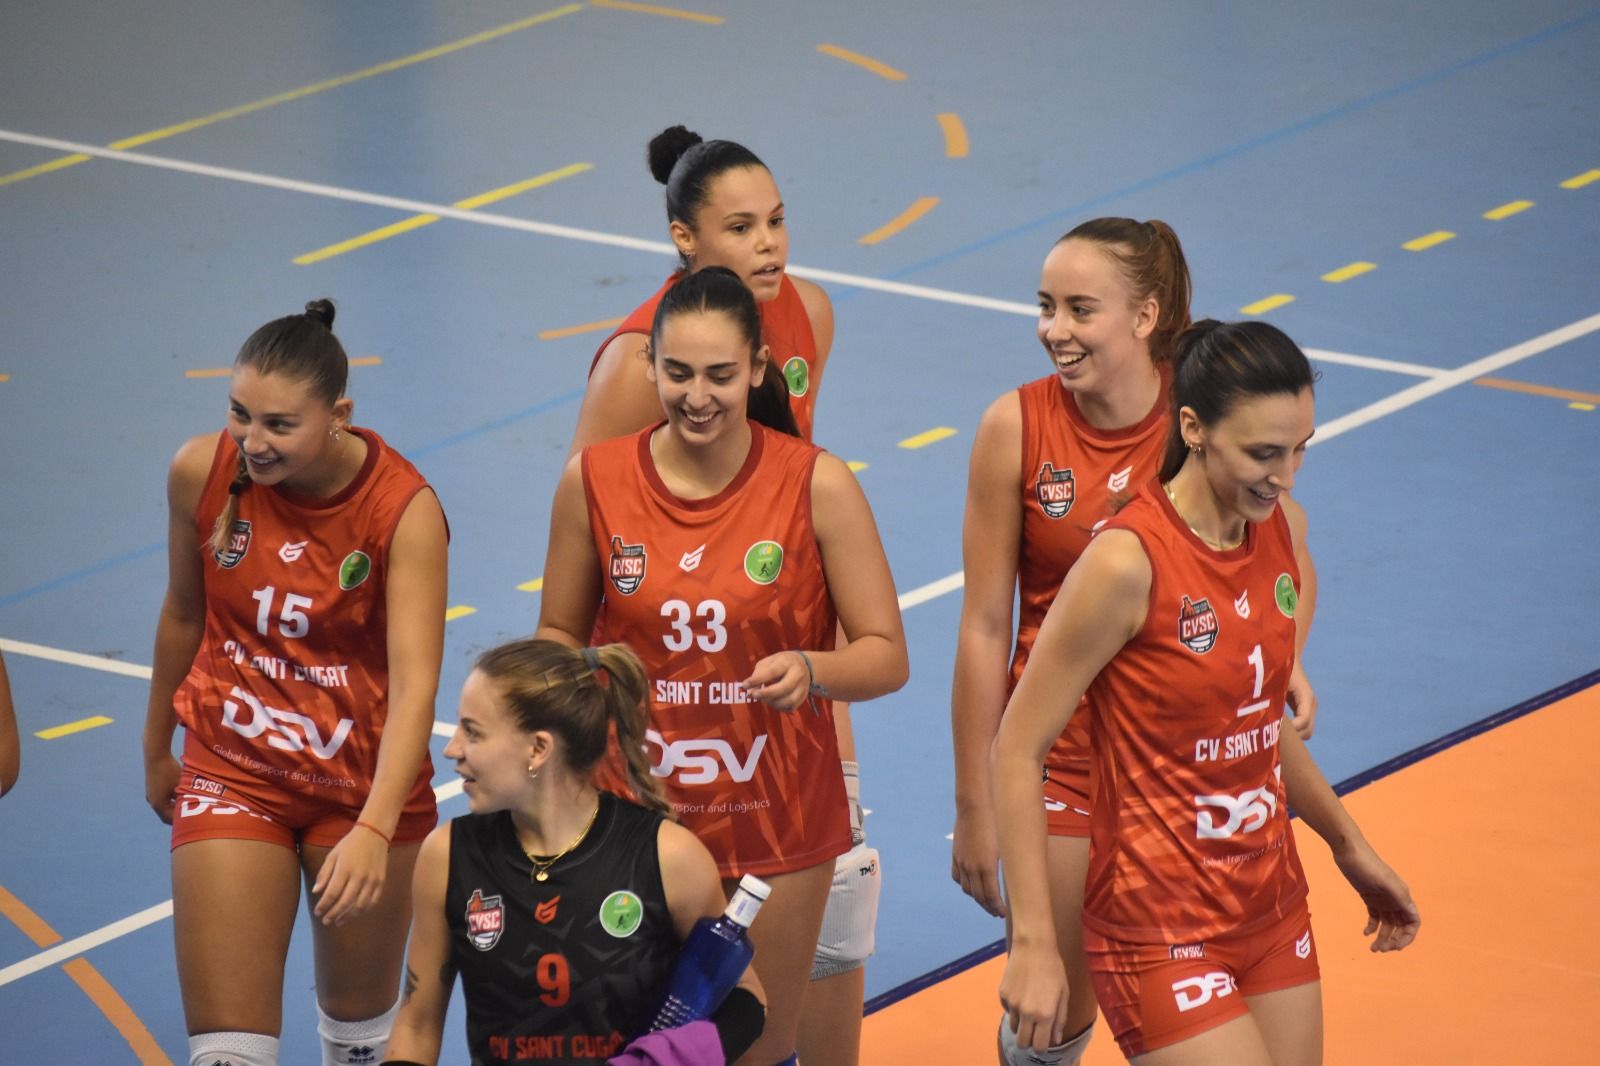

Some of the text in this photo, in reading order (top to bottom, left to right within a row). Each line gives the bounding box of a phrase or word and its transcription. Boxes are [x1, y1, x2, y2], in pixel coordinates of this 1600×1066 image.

[1040, 483, 1072, 501] CVSC
[612, 558, 643, 576] CVSC
[252, 585, 313, 639] 15
[1182, 611, 1216, 638] CVSC
[660, 599, 728, 652] 33
[250, 655, 288, 680] ANT
[1247, 644, 1266, 699] 1
[656, 679, 765, 705] SANT CUG
[221, 685, 355, 760] DSV
[1195, 738, 1221, 762] CV
[1224, 729, 1260, 760] SANT
[243, 755, 288, 778] Transport
[291, 770, 310, 782] and
[312, 774, 356, 788] Logistics
[193, 777, 224, 795] CVSC
[672, 800, 771, 814] nsport and Logistics
[468, 911, 501, 931] CVSC
[536, 953, 571, 1007] 9
[515, 1034, 565, 1060] SANT
